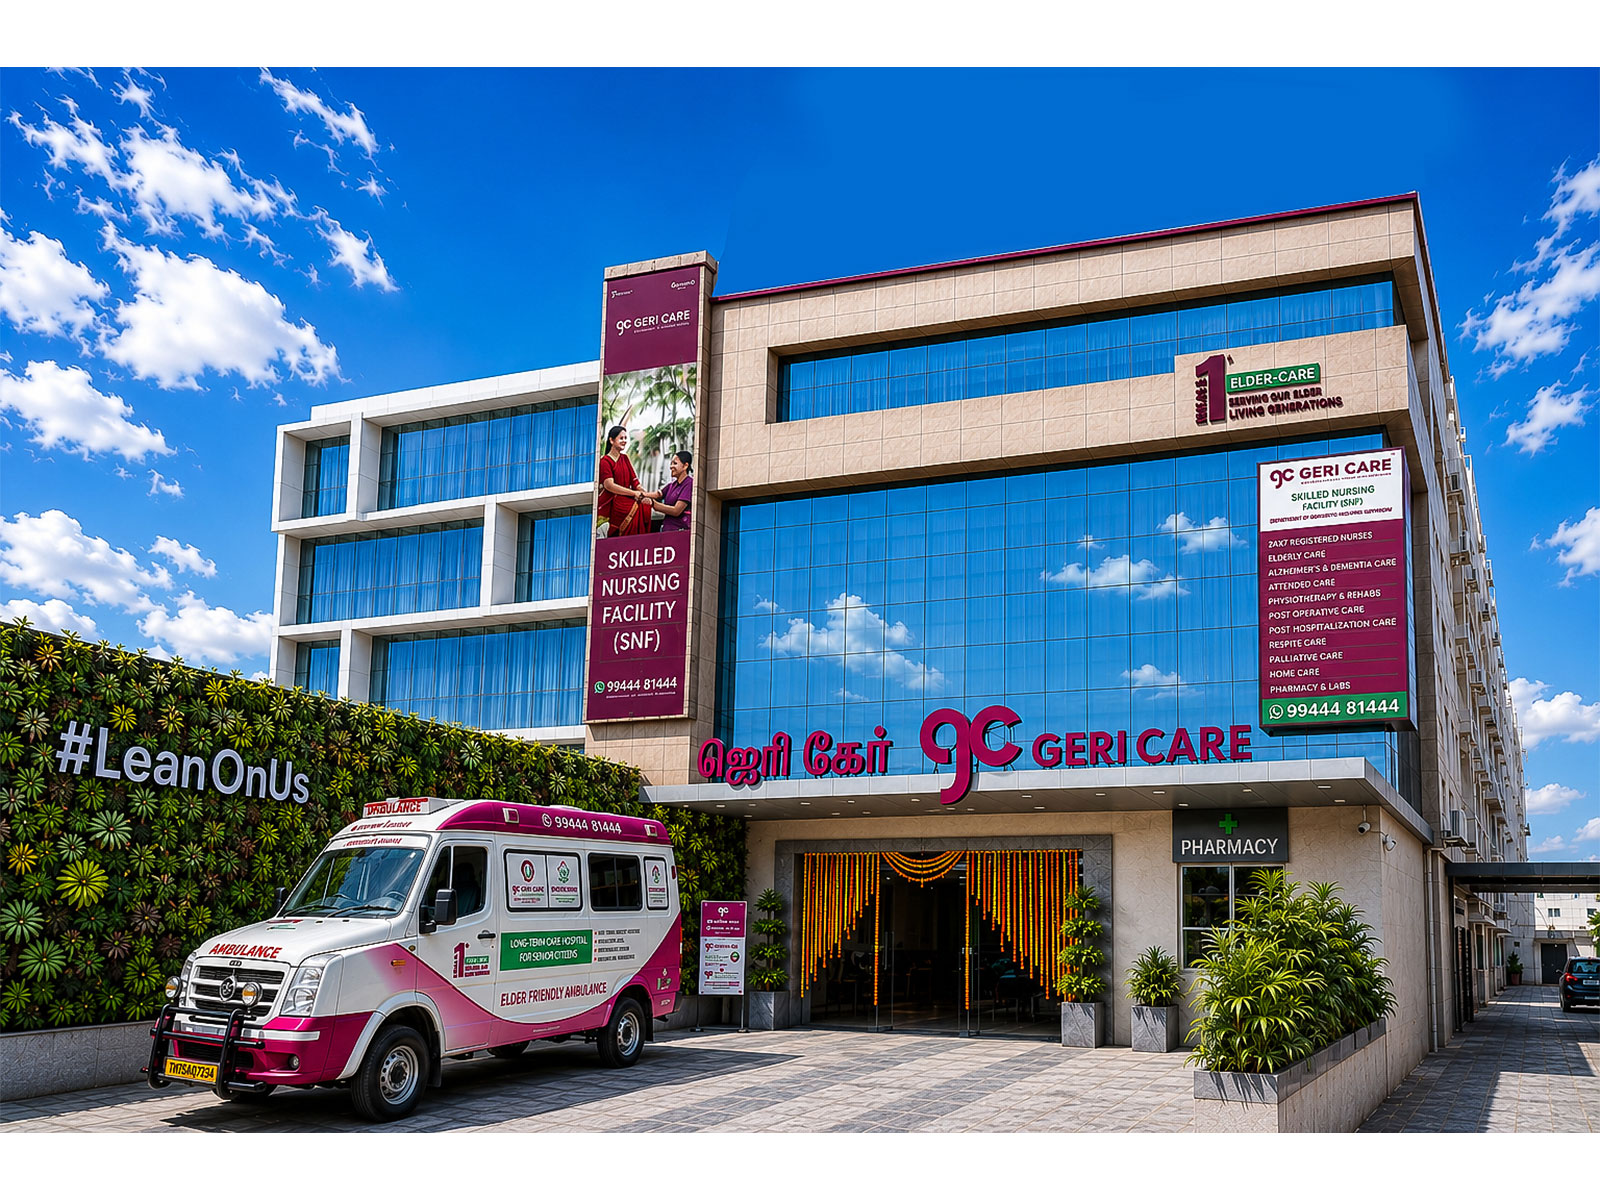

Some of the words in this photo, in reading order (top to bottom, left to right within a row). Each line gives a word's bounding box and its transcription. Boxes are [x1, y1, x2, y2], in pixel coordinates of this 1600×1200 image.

[633, 314, 659, 328] GERI
[660, 309, 691, 324] CARE
[1230, 367, 1316, 389] ELDER-CARE
[1228, 405, 1266, 420] LIVING
[1267, 396, 1344, 415] GENERATIONS
[1299, 463, 1340, 480] GERI
[1344, 458, 1392, 475] CARE
[1291, 489, 1330, 502] SKILLED
[1331, 484, 1375, 498] NURSING
[1302, 499, 1339, 511] FACILITY
[1289, 533, 1339, 547] REGISTERED
[1340, 531, 1373, 542] NURSES
[608, 546, 676, 570] SKILLED
[1268, 552, 1302, 563] ELDERLY
[1303, 549, 1326, 559] CARE
[1330, 559, 1373, 572] DEMENTIA
[1374, 557, 1397, 568] CARE
[602, 572, 680, 597] NURSING
[1268, 580, 1311, 591] ATTENDED
[1312, 578, 1336, 588] CARE
[1268, 592, 1337, 606] PHYSIOTHERAPY
[1346, 588, 1382, 599] REHABS
[602, 600, 677, 624] FACILITY
[1268, 610, 1291, 620] POST
[1292, 606, 1340, 618] OPERATIVE
[1341, 605, 1365, 614] CARE
[1268, 625, 1291, 635] POST
[1292, 619, 1371, 633] HOSPITALIZATION
[1372, 617, 1397, 627] CARE
[613, 628, 661, 655] (SNF)
[1269, 639, 1302, 649] RESPITE
[1303, 637, 1327, 647] CARE
[1269, 652, 1318, 664] PALLIATIVE
[1319, 651, 1344, 661] CARE
[1269, 669, 1296, 678] HOME
[1297, 667, 1321, 677] CARE
[606, 679, 641, 693] 99444
[643, 676, 678, 691] 81444
[1270, 683, 1319, 694] PHARMACY
[1328, 681, 1351, 691] LABS
[1286, 701, 1342, 718] 99444
[1346, 698, 1400, 715] 81444
[1031, 730, 1128, 769] GERI
[1136, 724, 1253, 764] CARE
[554, 815, 589, 831] 99444
[591, 819, 622, 835] 81444
[1181, 838, 1279, 855] PHARMACY
[208, 943, 283, 959] AMBULANCE
[500, 992, 527, 1007] ELDER
[528, 985, 565, 1003] FRIENDLY
[564, 981, 608, 998] AMBULANCE
